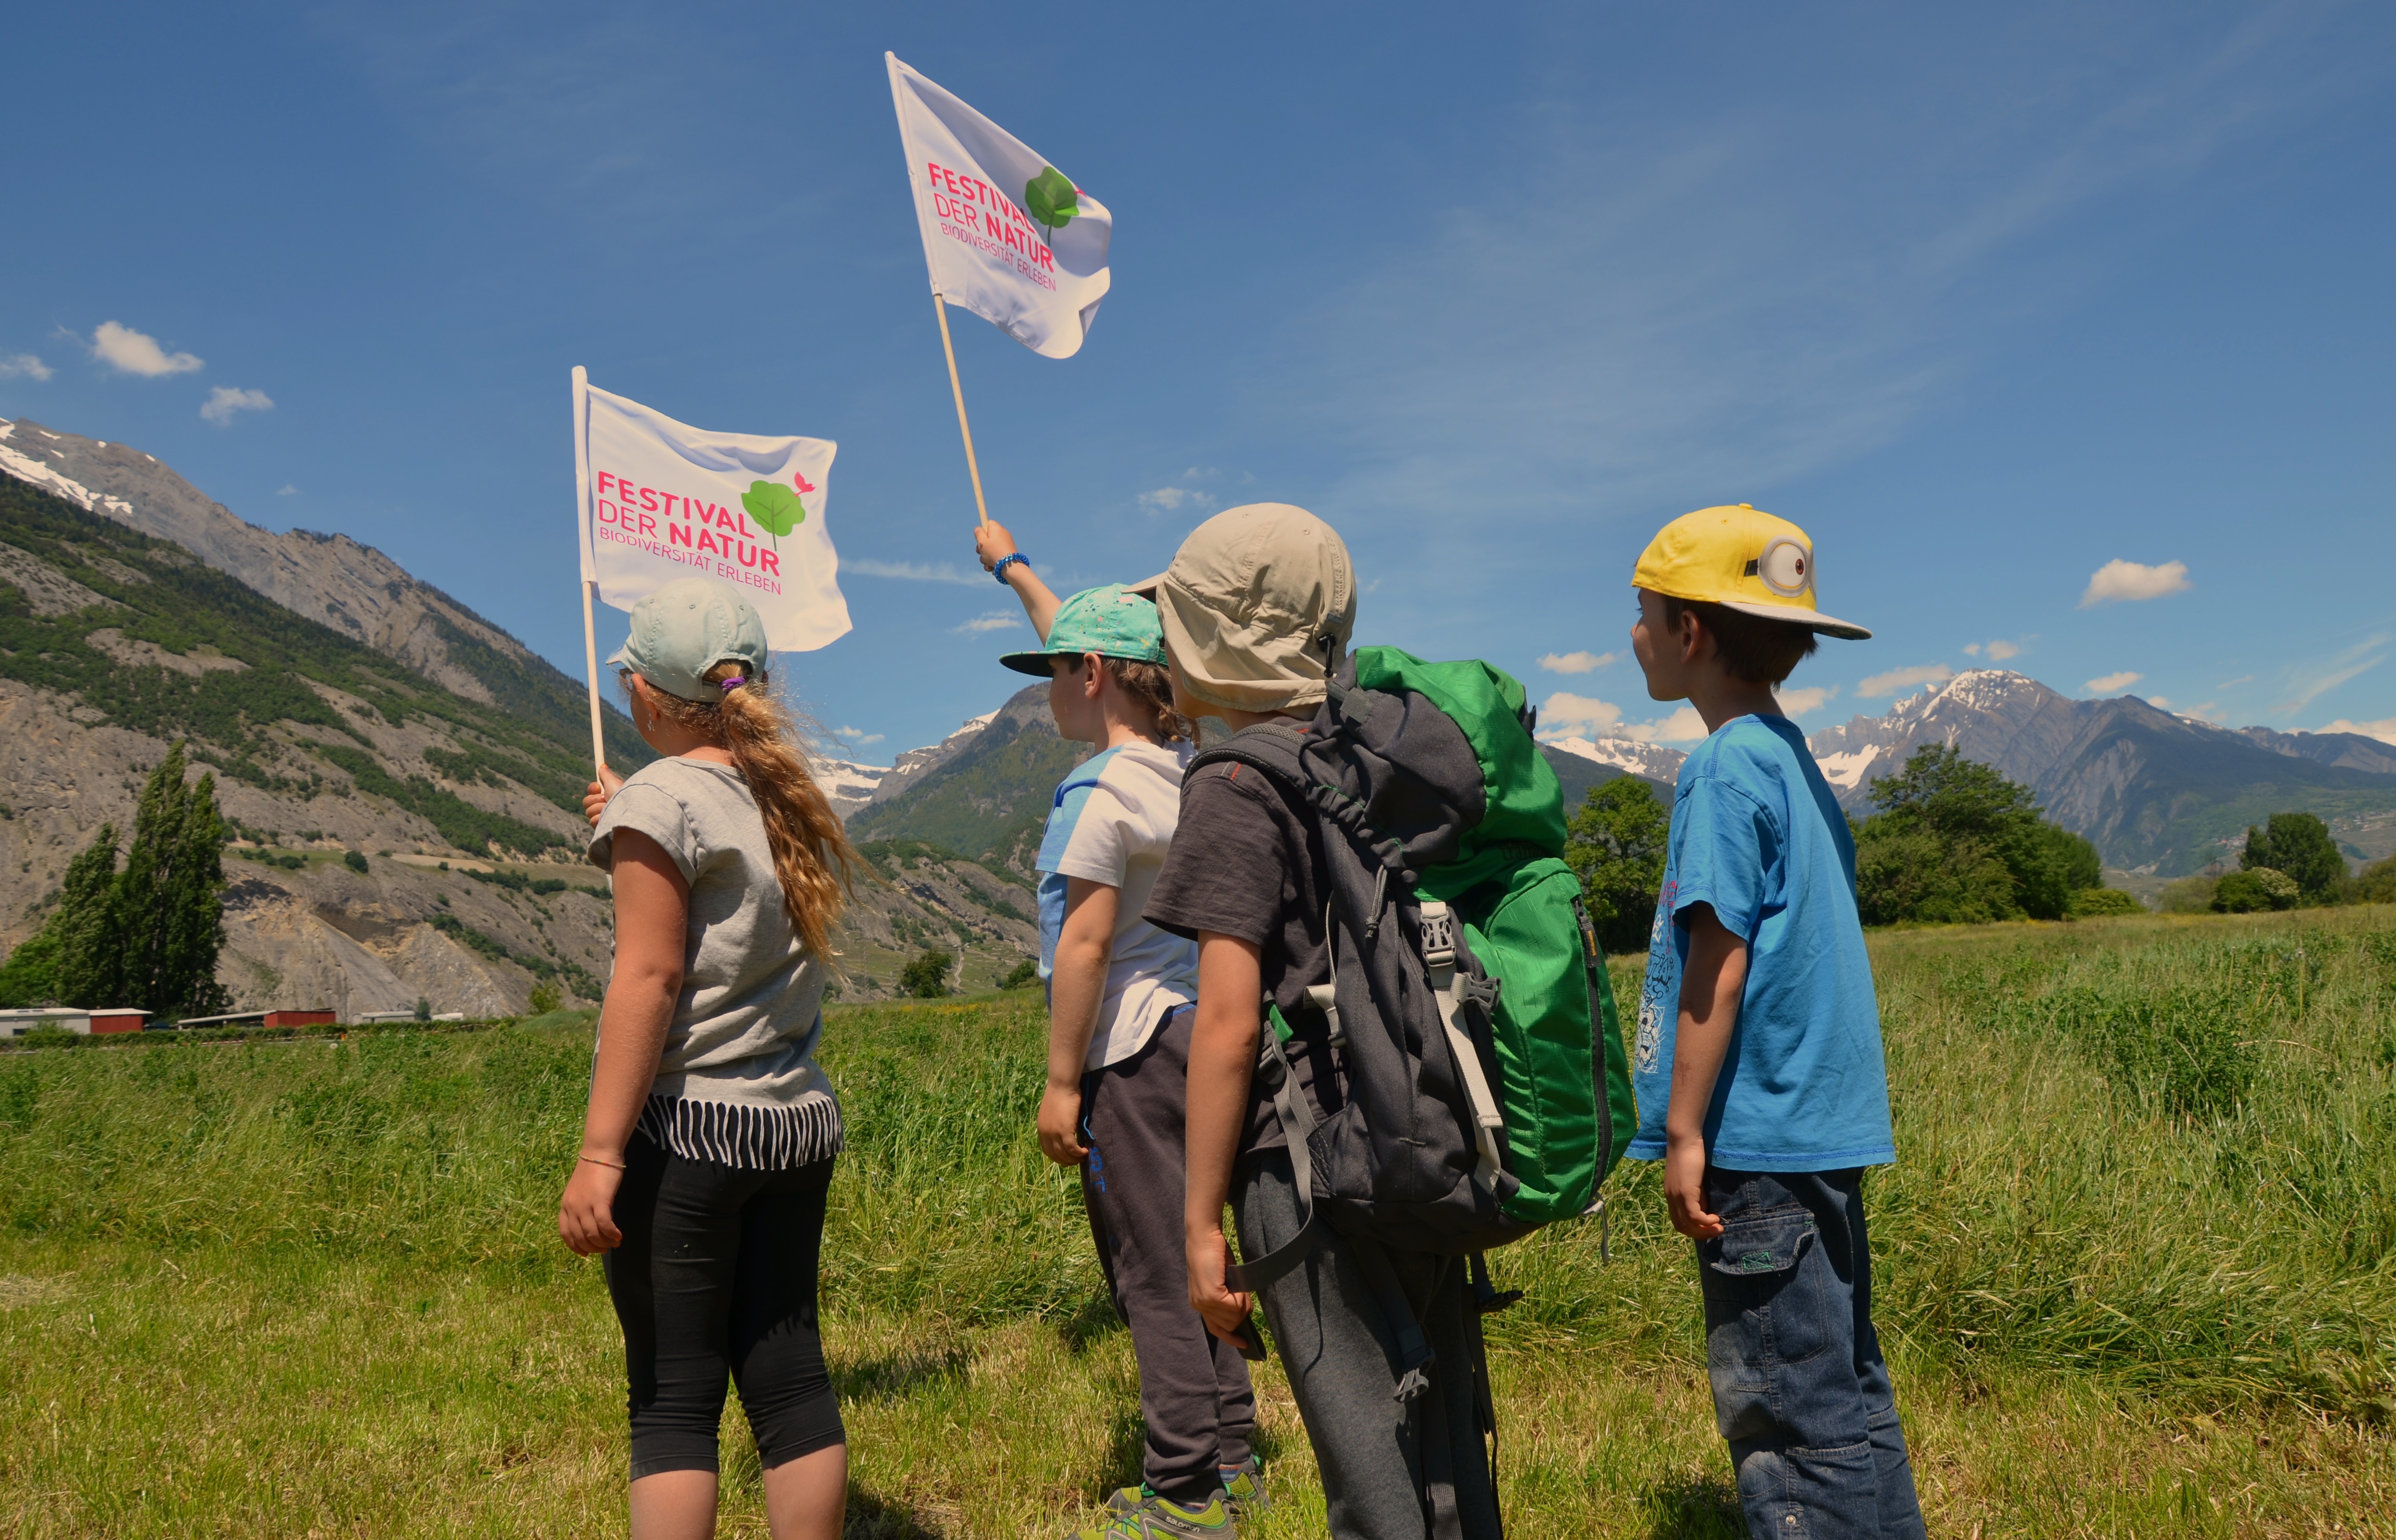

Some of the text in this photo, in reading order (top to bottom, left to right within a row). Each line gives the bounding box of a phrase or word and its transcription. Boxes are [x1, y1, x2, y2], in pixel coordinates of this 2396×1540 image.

[928, 162, 1035, 234] FESTIVAL
[934, 192, 1054, 273] DER NATUR
[940, 222, 1056, 292] BIODIVERSITÄT ERLEBEN
[599, 471, 755, 539] FESTIVAL
[599, 499, 780, 577] DER NATUR
[600, 527, 781, 595] BIODIVERSITÄT ERLEBEN
